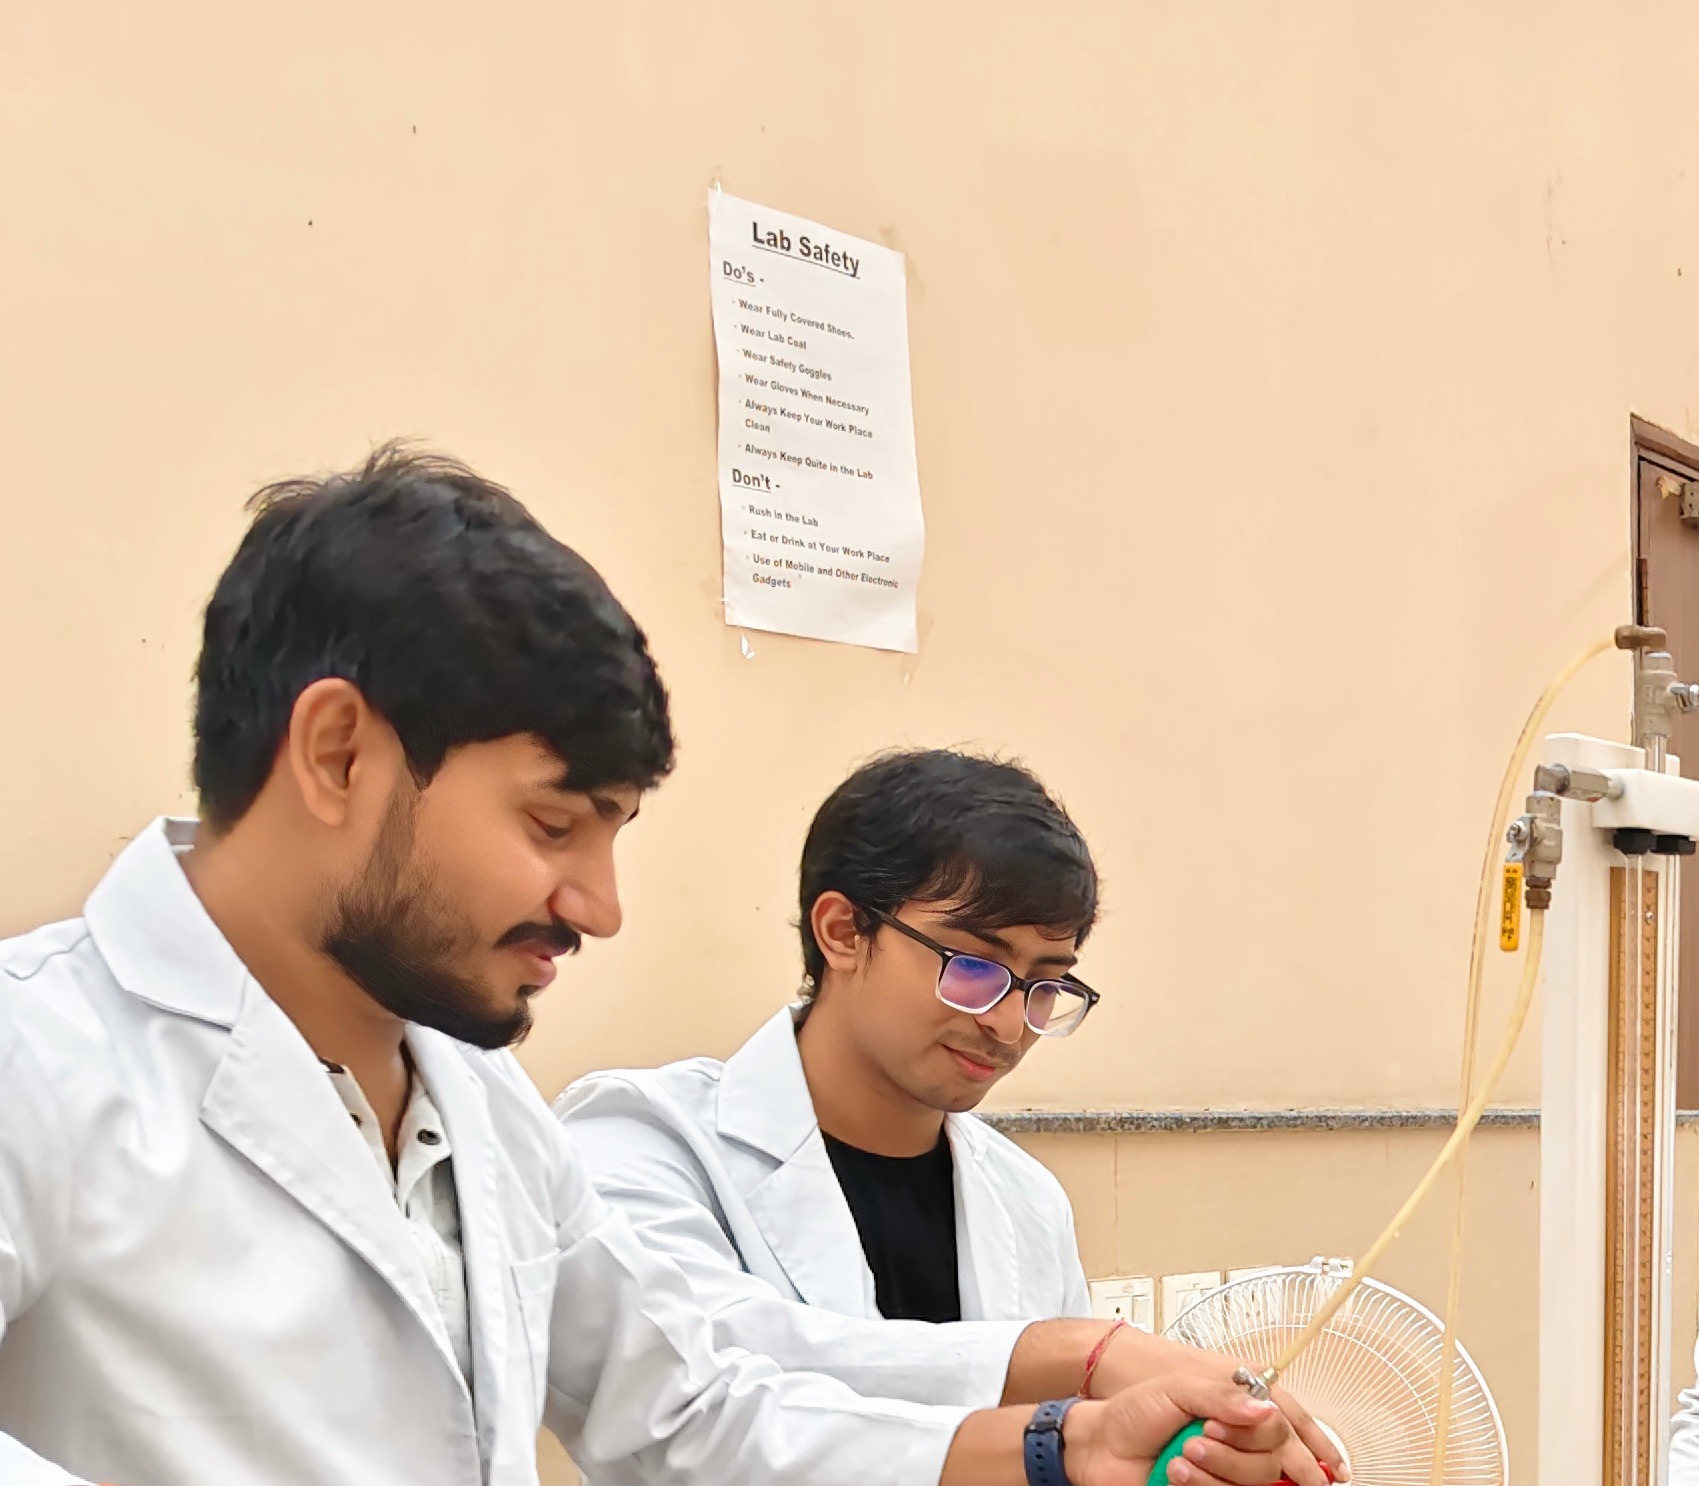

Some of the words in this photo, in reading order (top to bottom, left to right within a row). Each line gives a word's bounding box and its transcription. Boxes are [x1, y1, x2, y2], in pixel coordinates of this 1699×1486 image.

[752, 221, 791, 251] Lab
[799, 236, 860, 277] Safety
[722, 260, 755, 283] Do's
[738, 299, 763, 313] Wear
[766, 306, 787, 322] Fully
[790, 312, 825, 330] Covered
[740, 323, 765, 338] Wear
[768, 331, 785, 343] Lab
[742, 348, 767, 363] Wear
[770, 355, 796, 373] Safety
[745, 373, 768, 387] Wear
[770, 381, 798, 396] Gloves
[800, 388, 823, 402] When
[826, 395, 869, 416] Necessary
[745, 399, 778, 415] Always
[780, 408, 802, 422] Keep
[804, 413, 823, 426] Your
[825, 419, 846, 432] Work
[849, 425, 873, 438] Place
[745, 419, 771, 433] Clean
[745, 443, 777, 460] Always
[780, 451, 802, 466] Keep
[840, 465, 854, 476] the
[857, 468, 873, 479] Lab
[731, 468, 771, 490] Don't
[749, 504, 771, 518] Rush
[785, 512, 800, 523] the
[802, 515, 819, 527] Lab
[751, 529, 767, 541] Eat
[769, 534, 779, 543] or
[781, 536, 805, 549] Drink
[807, 540, 817, 551] at
[819, 542, 840, 554] Your
[842, 546, 864, 559] Work
[867, 550, 890, 564] Place
[752, 554, 771, 567] Use
[773, 557, 783, 568] of
[785, 560, 815, 574] Mobile
[817, 566, 833, 577] and
[835, 568, 859, 582] Other
[861, 573, 899, 589] Electronic
[752, 573, 792, 589] Gadgets
